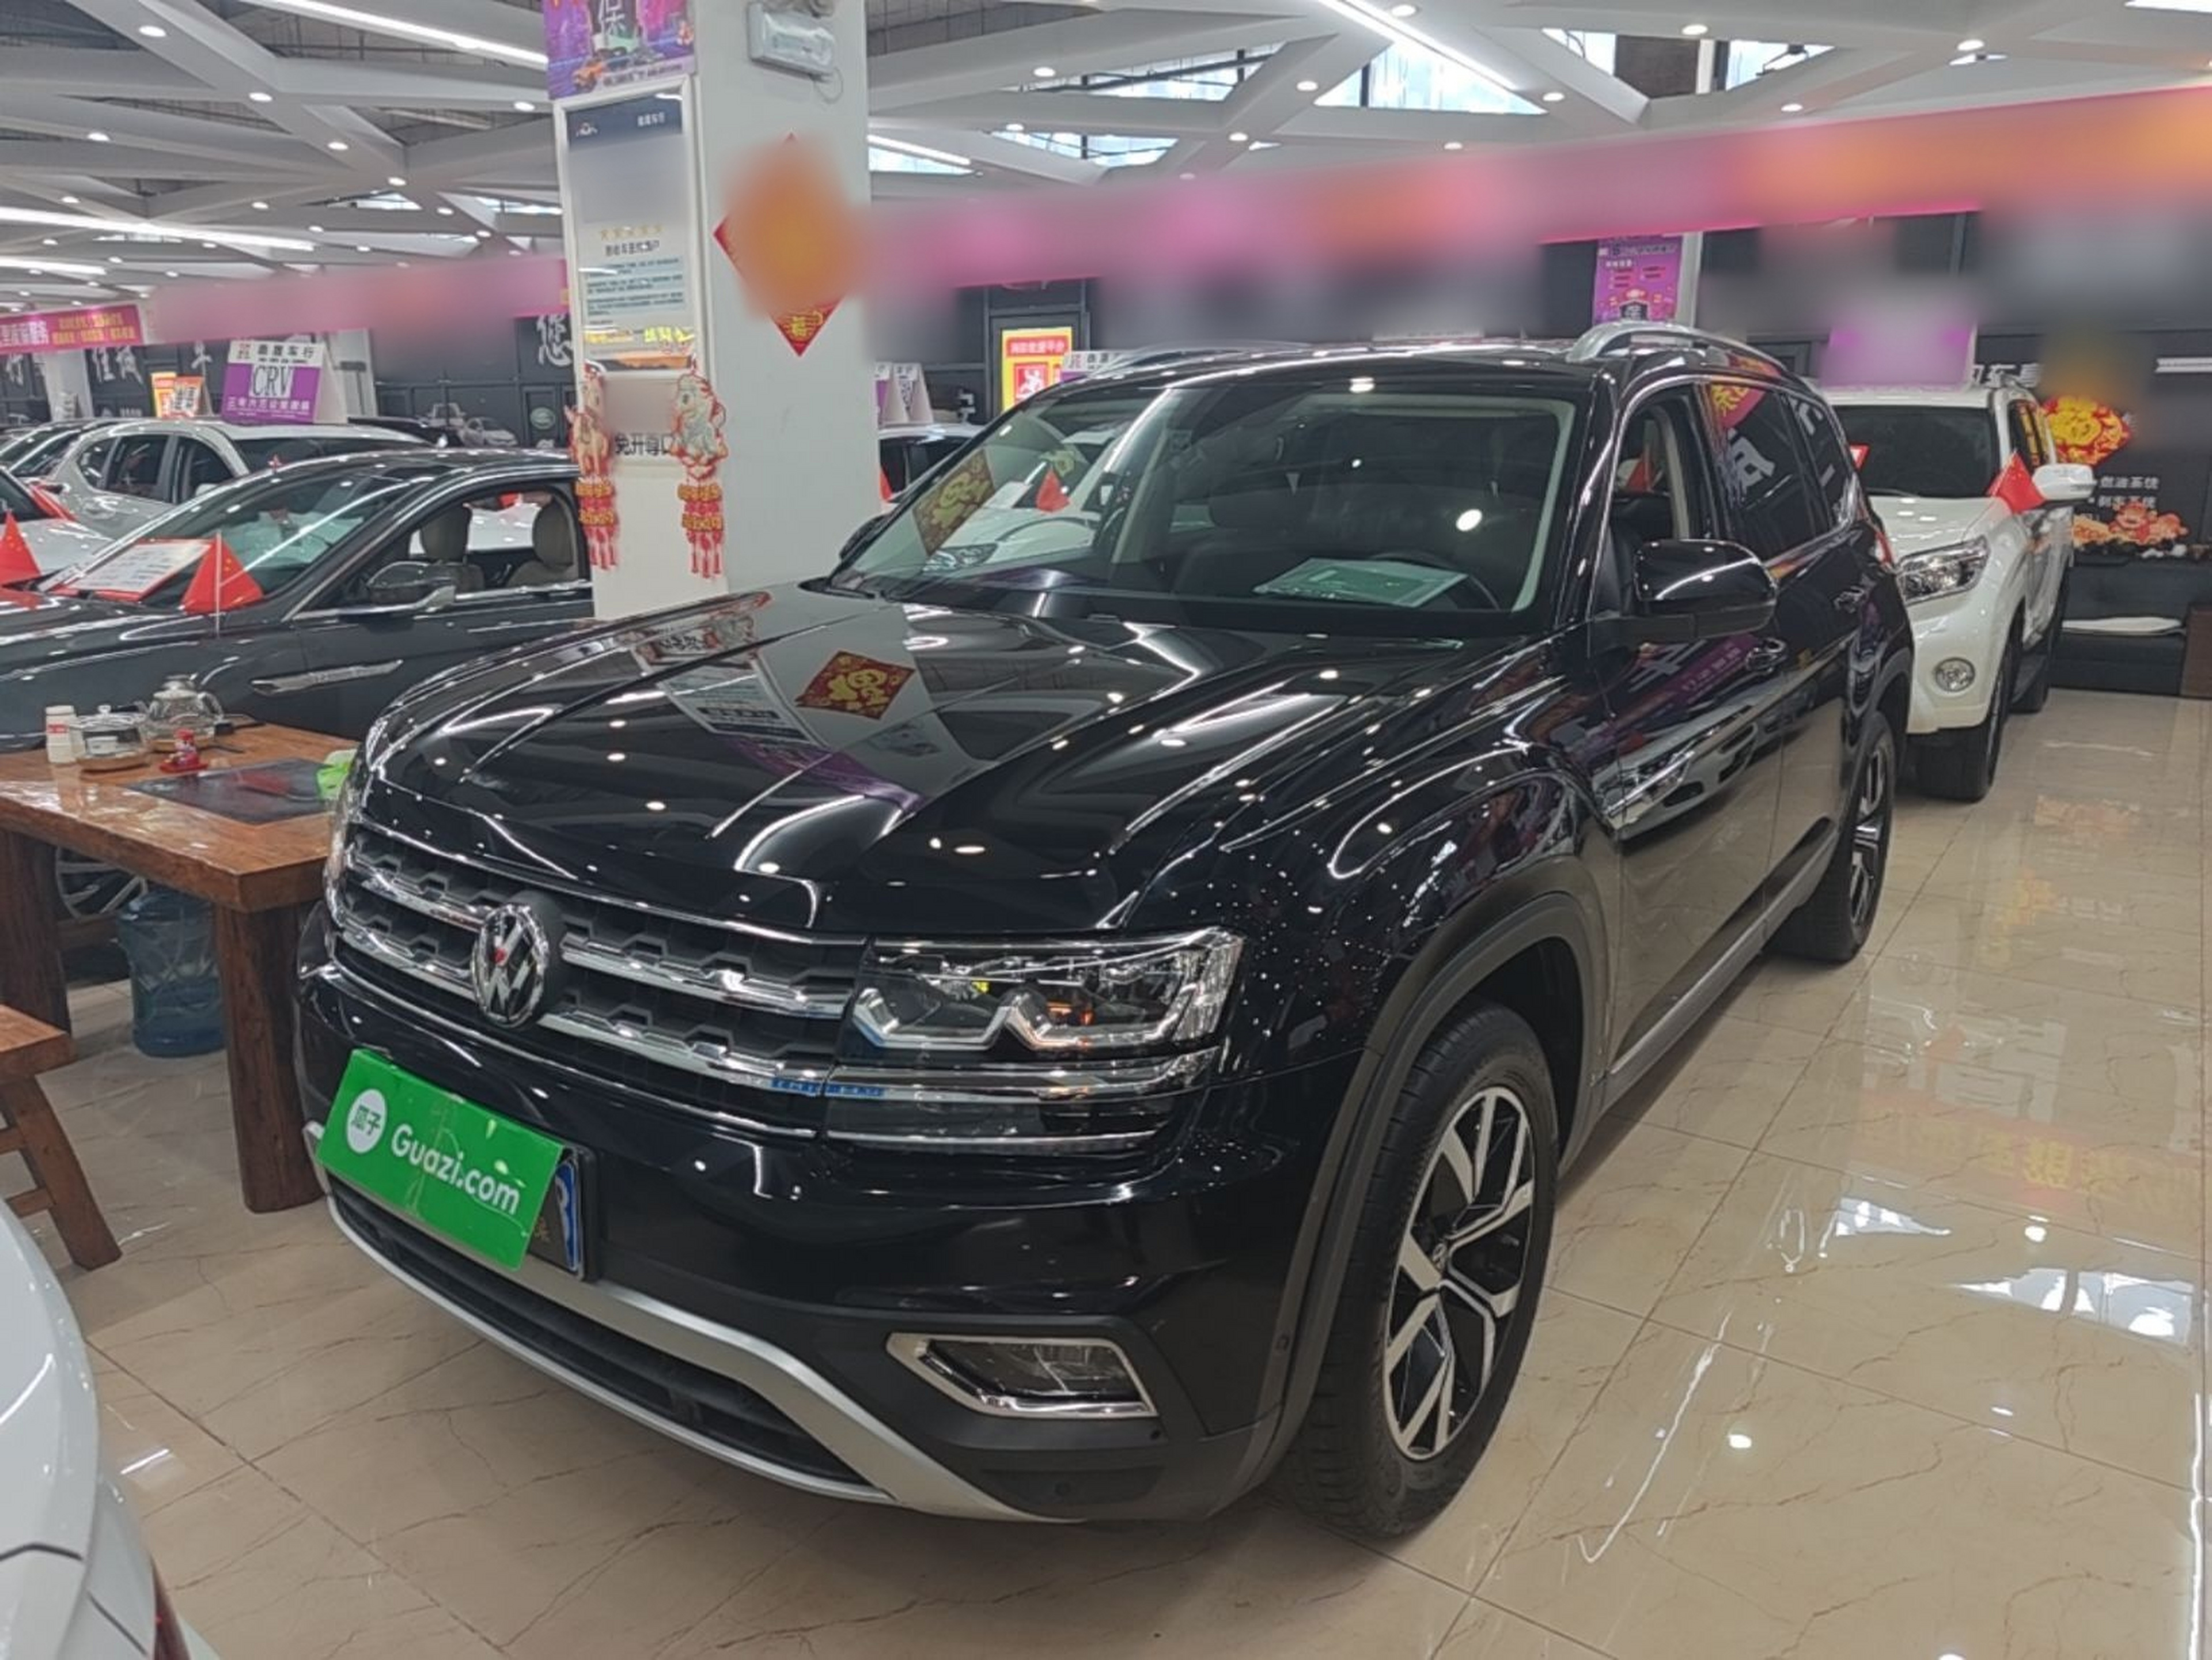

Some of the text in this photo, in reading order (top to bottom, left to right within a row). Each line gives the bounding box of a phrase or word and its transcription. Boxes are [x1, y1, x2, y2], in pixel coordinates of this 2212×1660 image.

[252, 365, 294, 396] CRV
[351, 1104, 381, 1136] 瓜子
[391, 1124, 521, 1215] Guazi.com
